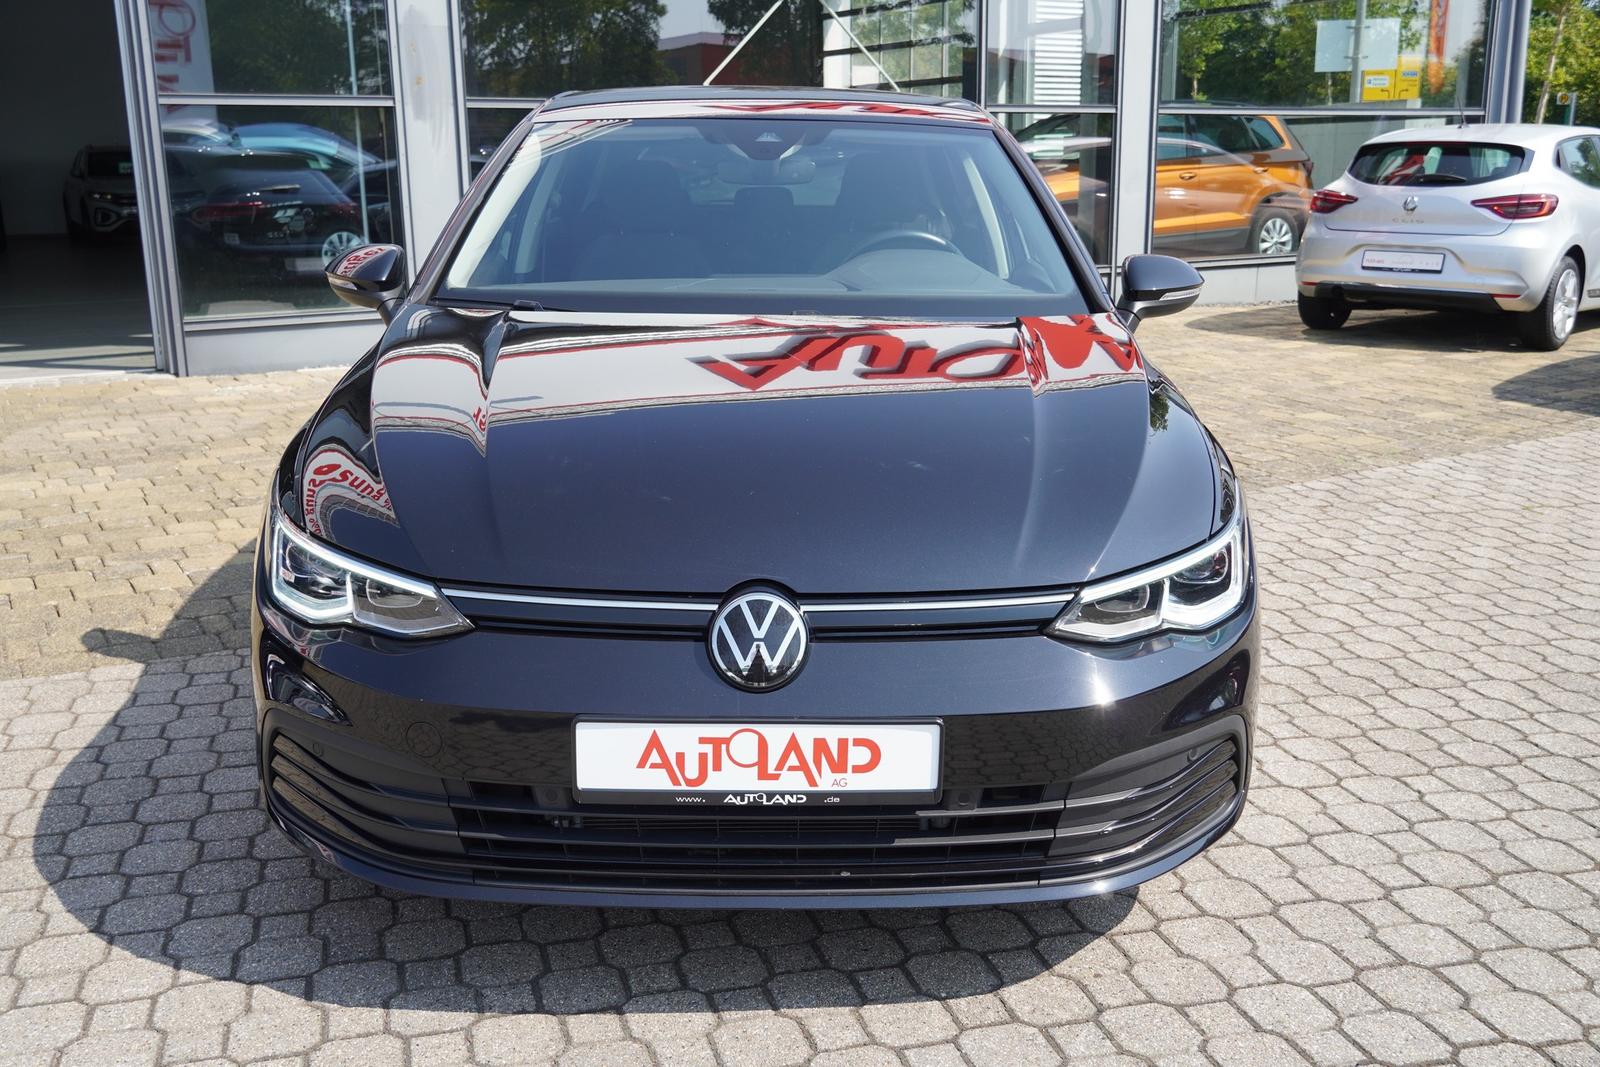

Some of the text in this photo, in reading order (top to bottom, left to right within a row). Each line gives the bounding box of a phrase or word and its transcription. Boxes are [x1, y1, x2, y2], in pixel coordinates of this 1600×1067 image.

[636, 728, 882, 788] AUTOLAND
[831, 778, 848, 788] AG
[723, 792, 807, 805] AUTOLAND
